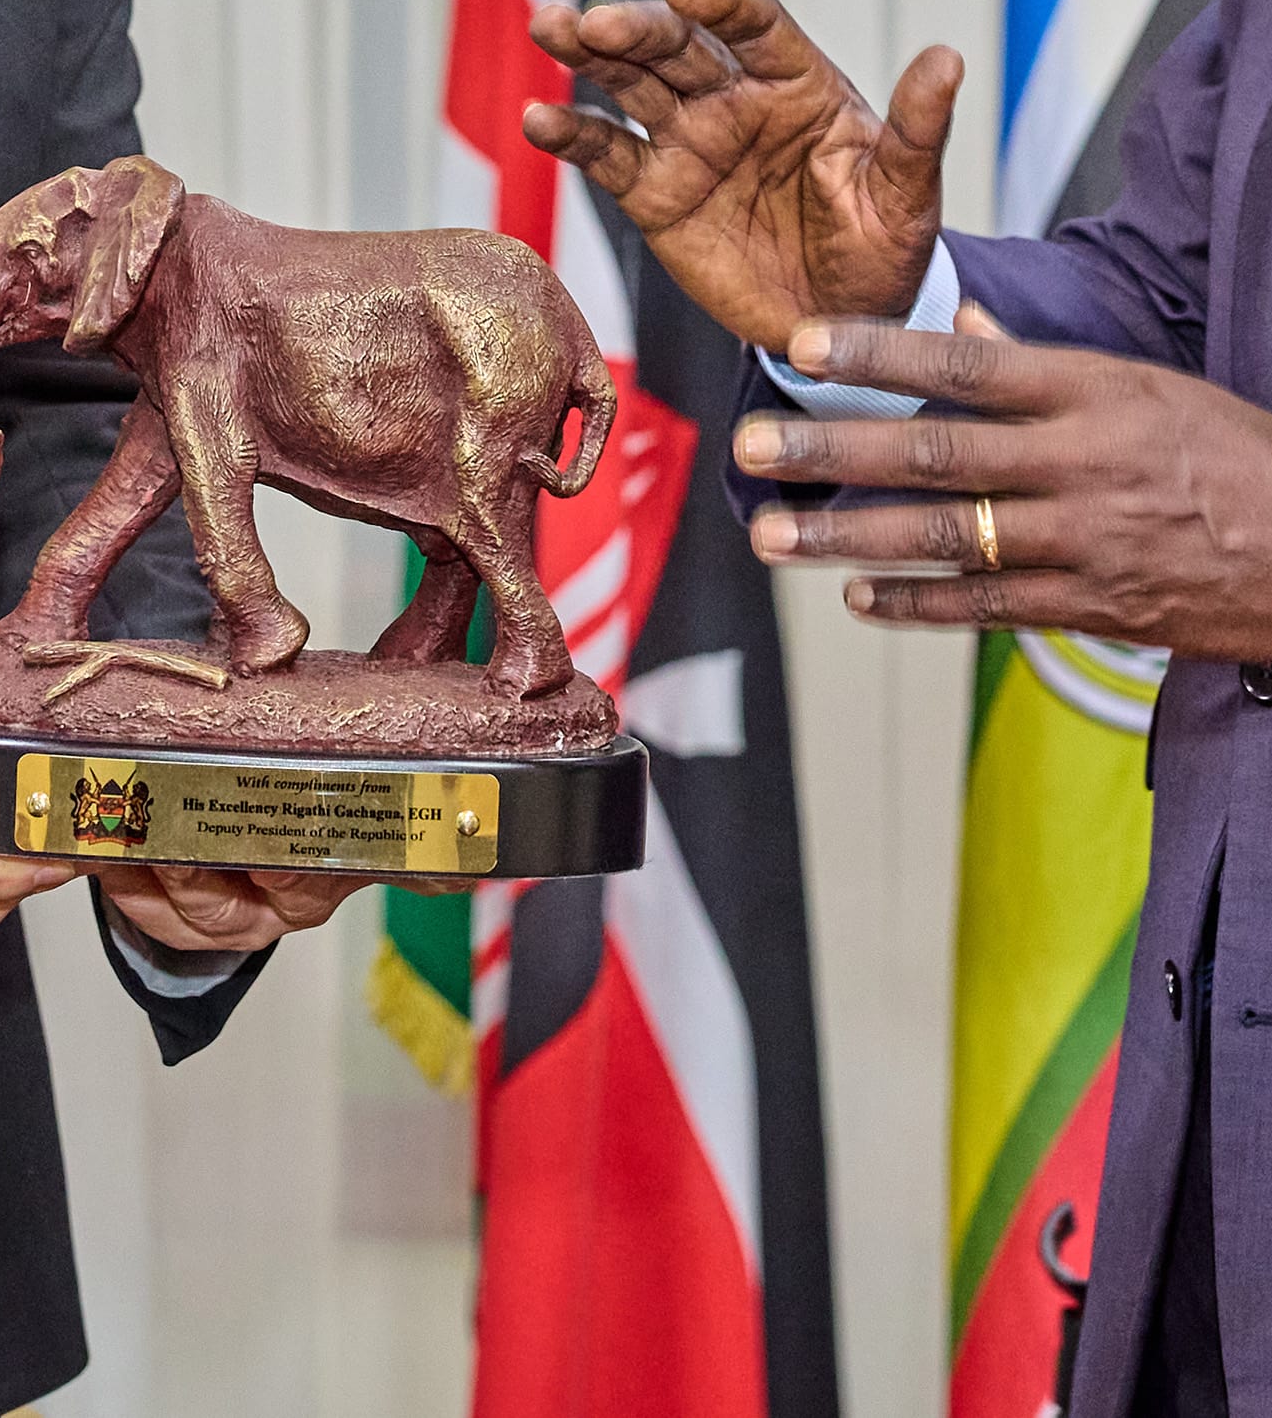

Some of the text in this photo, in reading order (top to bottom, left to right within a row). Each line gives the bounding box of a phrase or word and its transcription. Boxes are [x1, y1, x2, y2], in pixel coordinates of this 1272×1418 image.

[236, 775, 391, 797] With compliments from
[183, 797, 442, 821] His Excellency Rigathi Gachagua, EGH
[197, 821, 426, 842] Deputy President of the Republic of
[289, 843, 331, 858] Kenya
